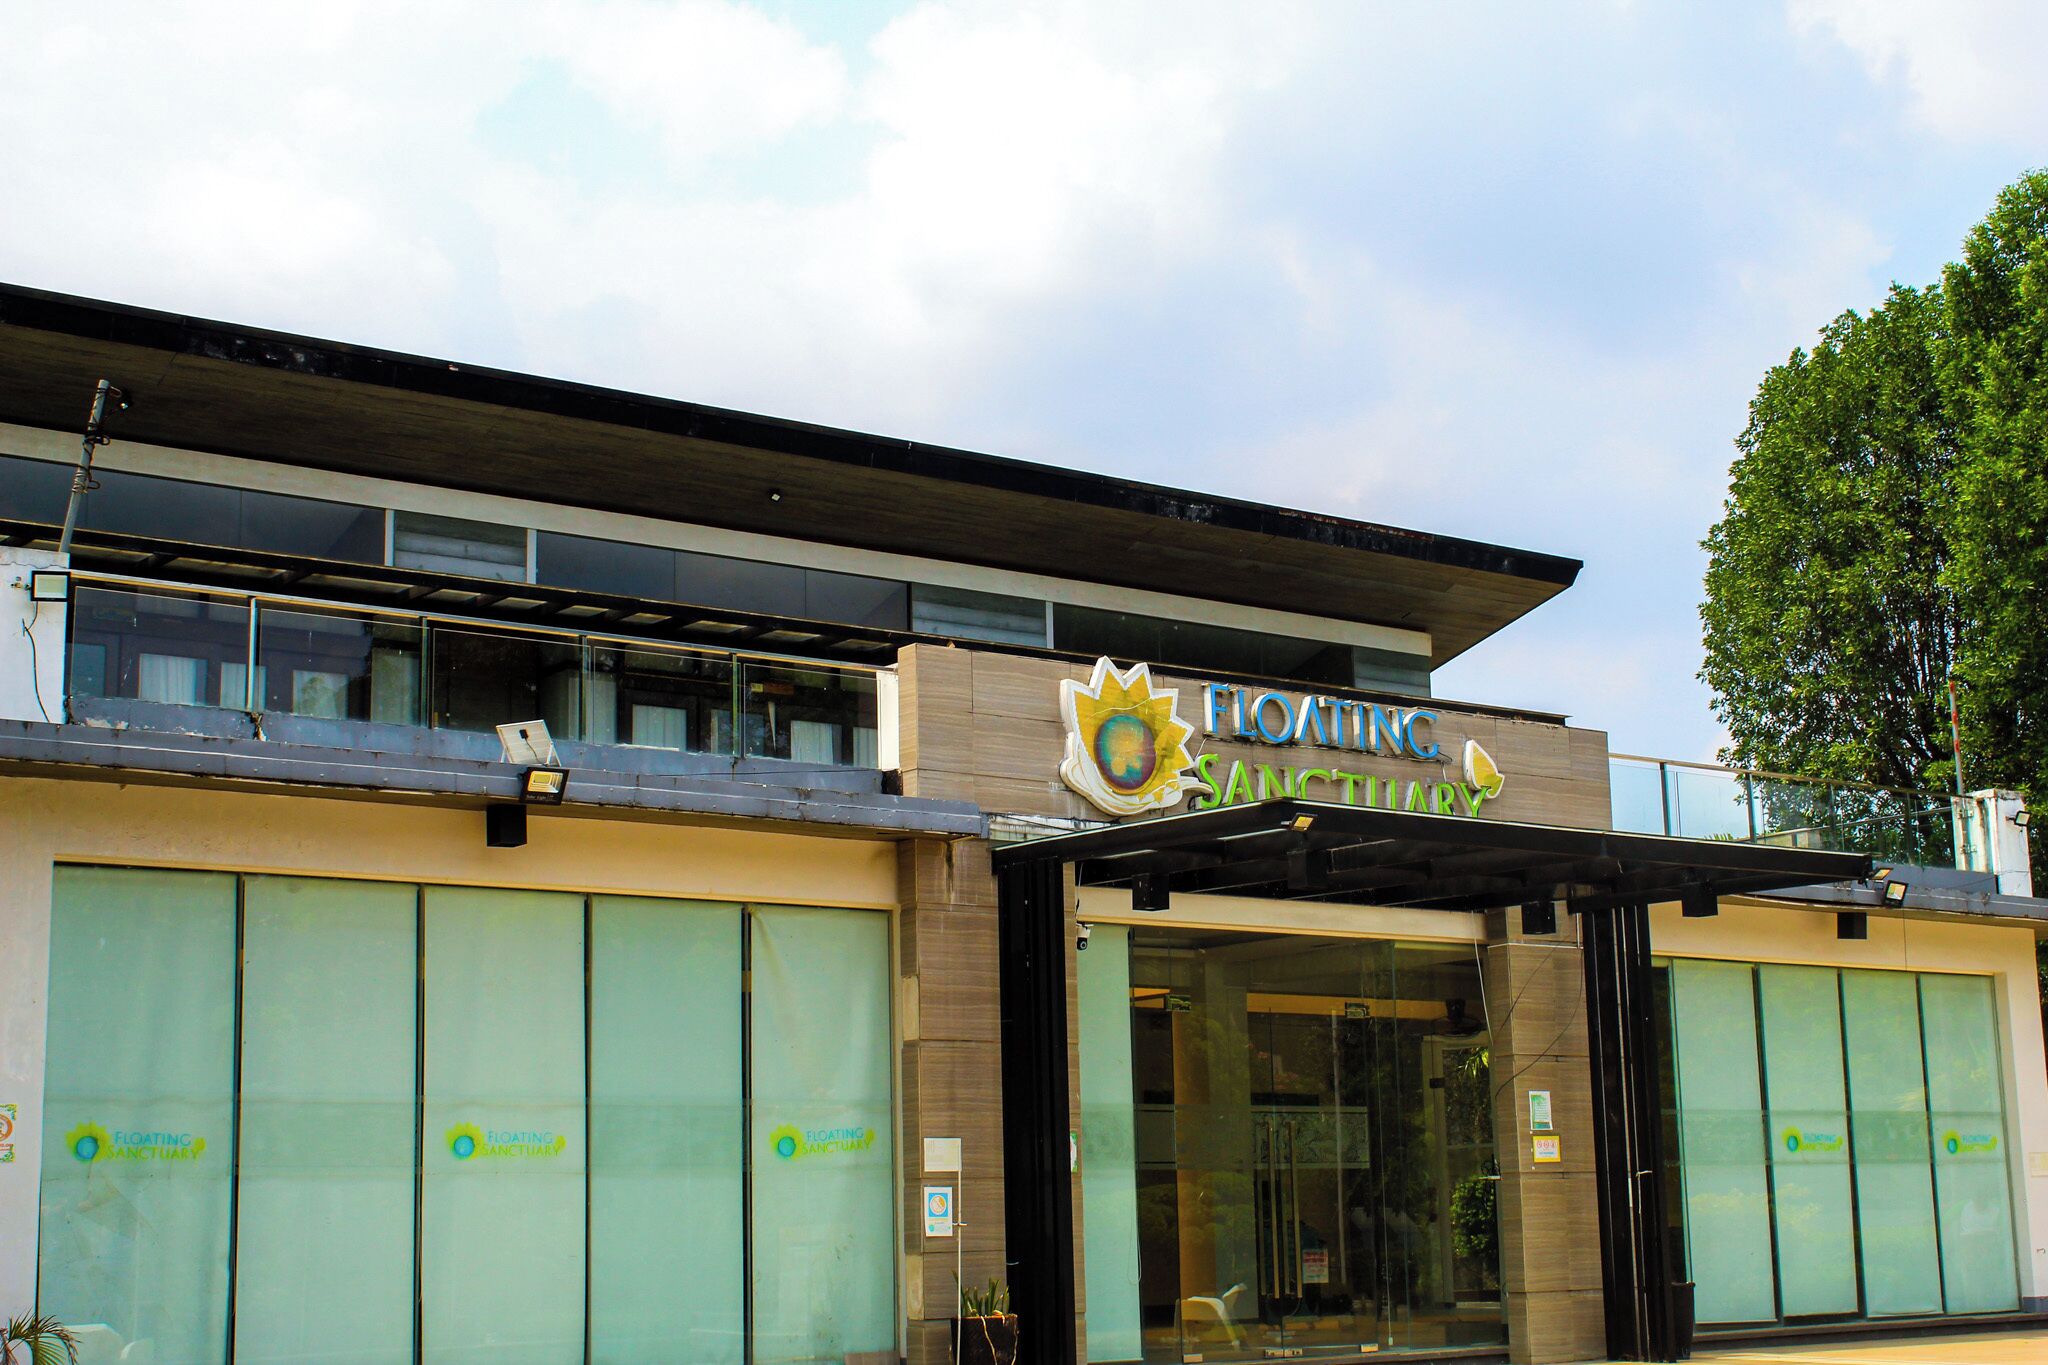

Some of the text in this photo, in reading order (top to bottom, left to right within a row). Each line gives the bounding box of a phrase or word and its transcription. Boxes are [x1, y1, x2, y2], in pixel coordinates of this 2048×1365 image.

[1201, 682, 1440, 758] FLOATING
[1197, 753, 1490, 818] SANCTUARY
[113, 1131, 192, 1146] FLOATING
[488, 1131, 553, 1144] FLOATING
[807, 1127, 864, 1142] FLOATING
[106, 1146, 198, 1160] SANCTUARY
[482, 1144, 560, 1157] SANCTUARY
[801, 1140, 871, 1154] SANCTUARY
